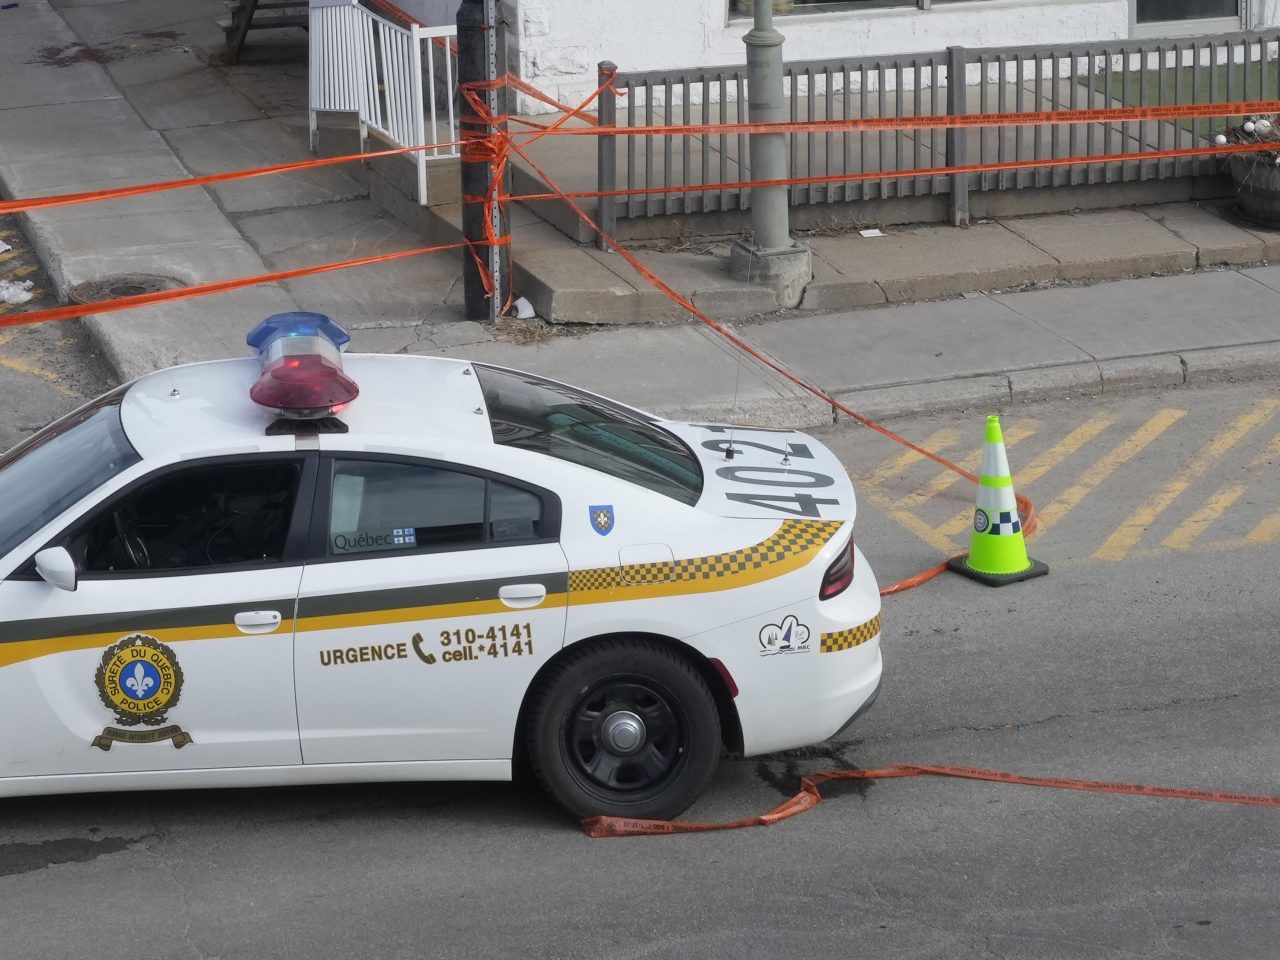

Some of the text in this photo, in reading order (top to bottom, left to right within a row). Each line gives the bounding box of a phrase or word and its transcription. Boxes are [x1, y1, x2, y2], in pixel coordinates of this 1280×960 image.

[334, 530, 392, 551] Québec
[439, 622, 533, 647] 310-4141
[130, 649, 146, 658] DU
[320, 642, 408, 667] URGENCE
[119, 697, 163, 711] POLICE
